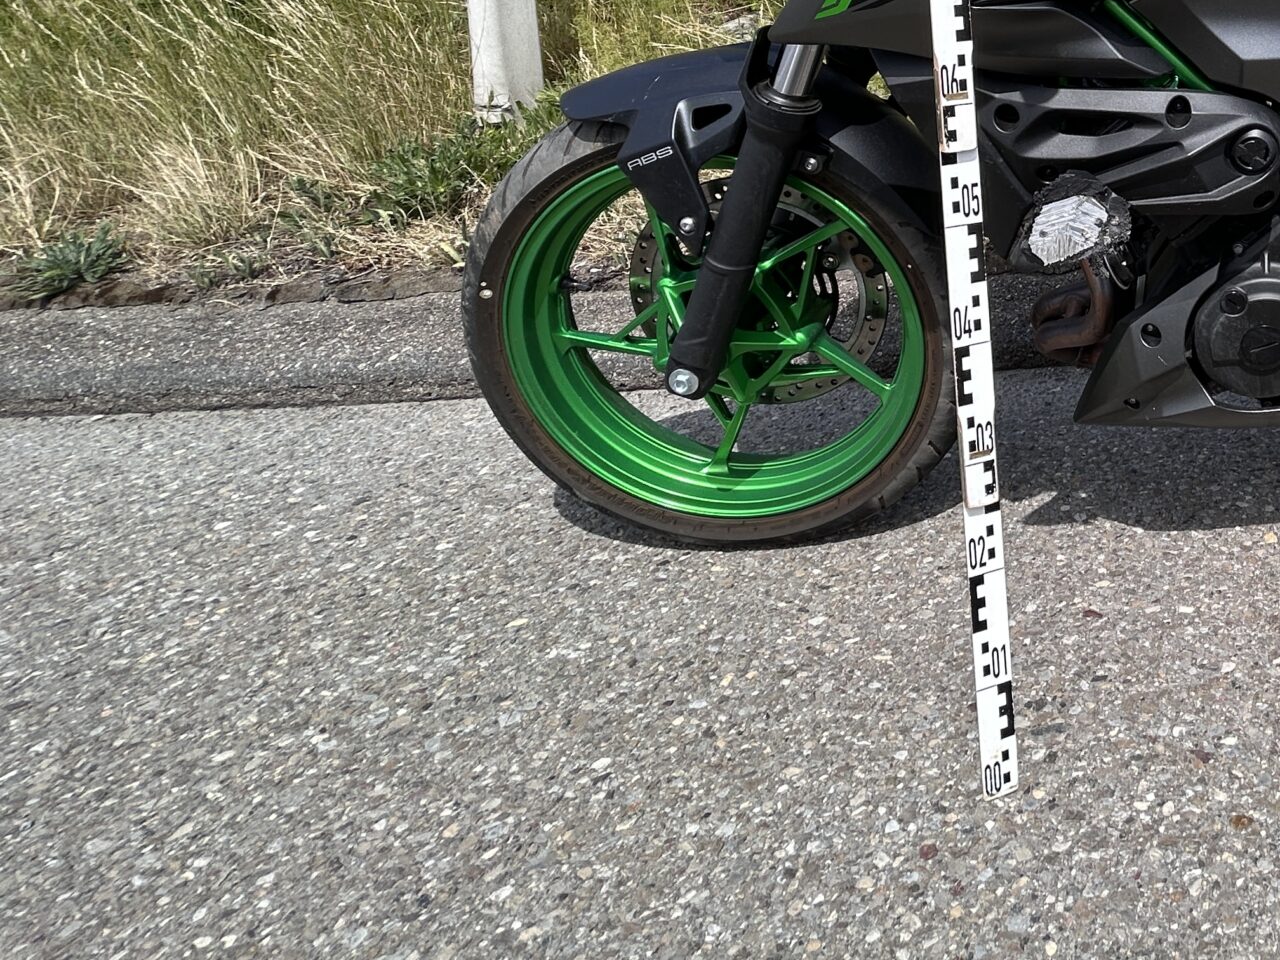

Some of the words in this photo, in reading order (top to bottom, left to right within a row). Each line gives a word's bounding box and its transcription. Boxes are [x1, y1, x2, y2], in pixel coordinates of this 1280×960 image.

[940, 64, 960, 97] 06
[626, 145, 674, 171] ABS
[961, 185, 980, 217] 05
[953, 306, 973, 340] 04
[976, 421, 994, 454] 03
[968, 536, 986, 570] 02
[991, 646, 1010, 677] 01
[984, 762, 1003, 797] 00
